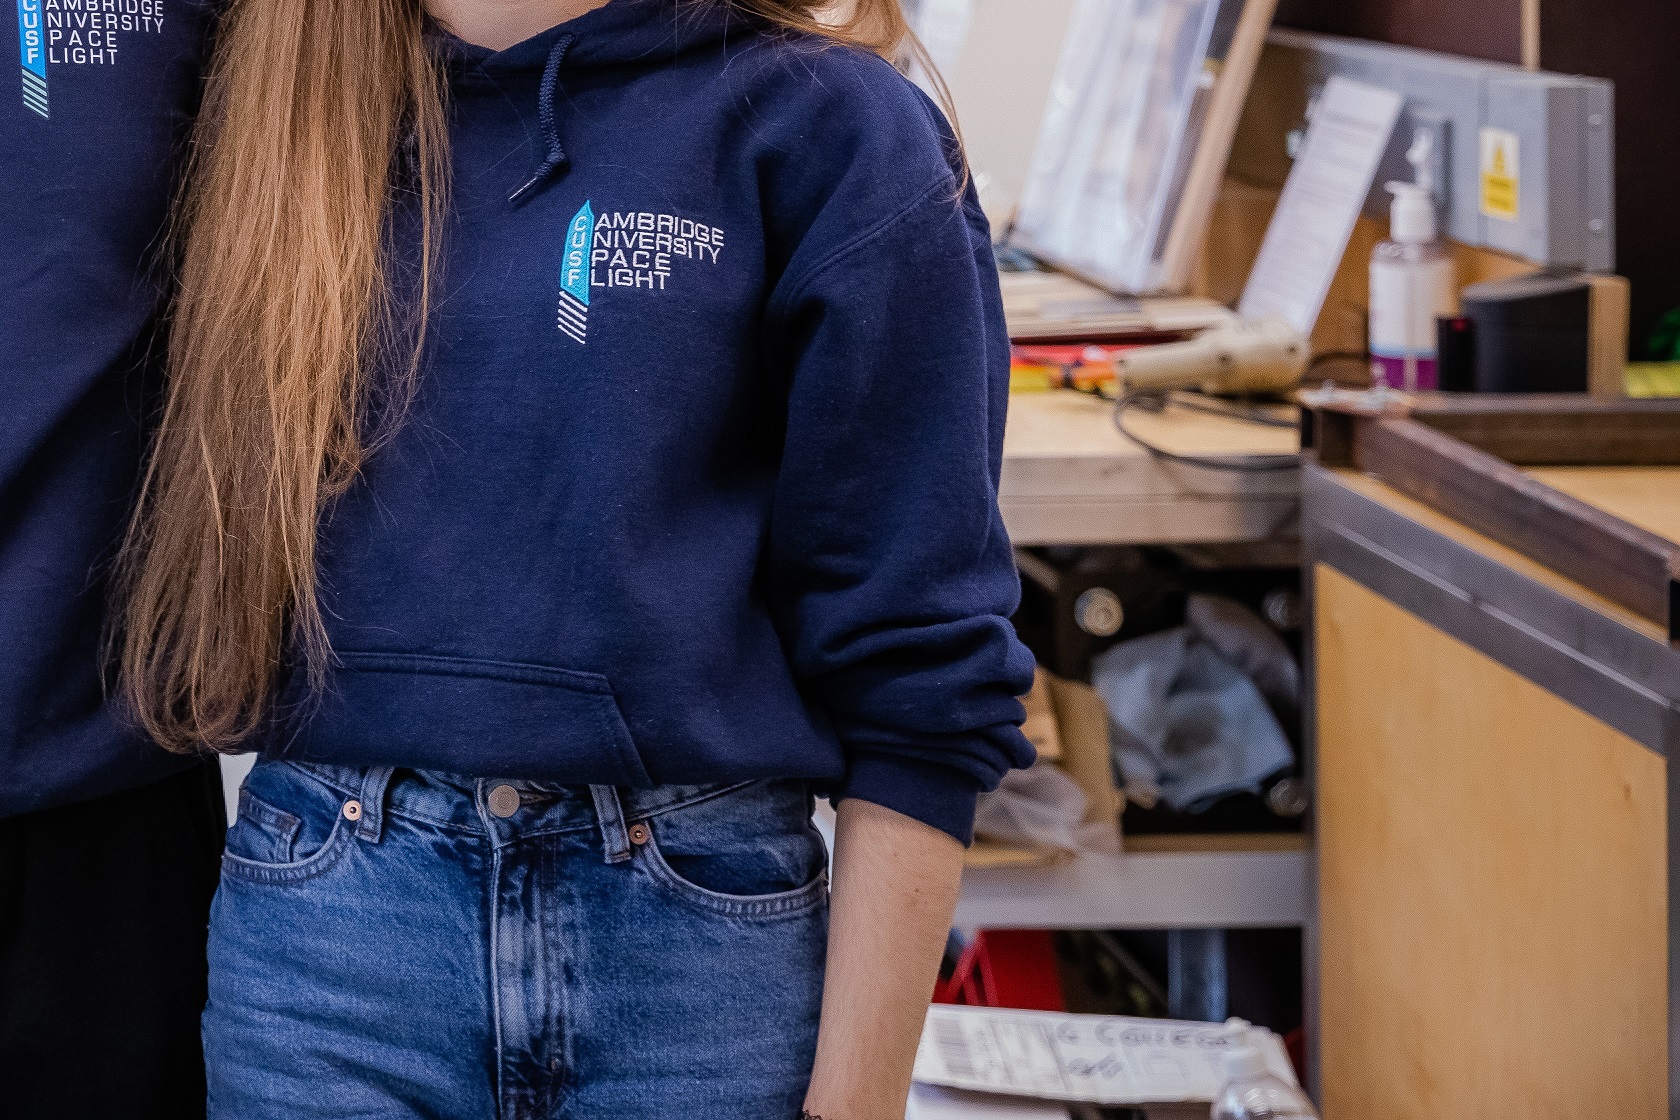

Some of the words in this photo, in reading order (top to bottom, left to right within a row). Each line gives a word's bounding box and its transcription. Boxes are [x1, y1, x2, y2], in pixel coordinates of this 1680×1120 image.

[47, 12, 164, 33] NIVERSITY
[49, 29, 117, 47] PACE
[49, 47, 118, 64] LIGHT
[594, 212, 724, 246] AMBRIDGE
[593, 230, 720, 264] NIVERSITY
[591, 249, 670, 270] PACE
[591, 269, 670, 289] LIGHT
